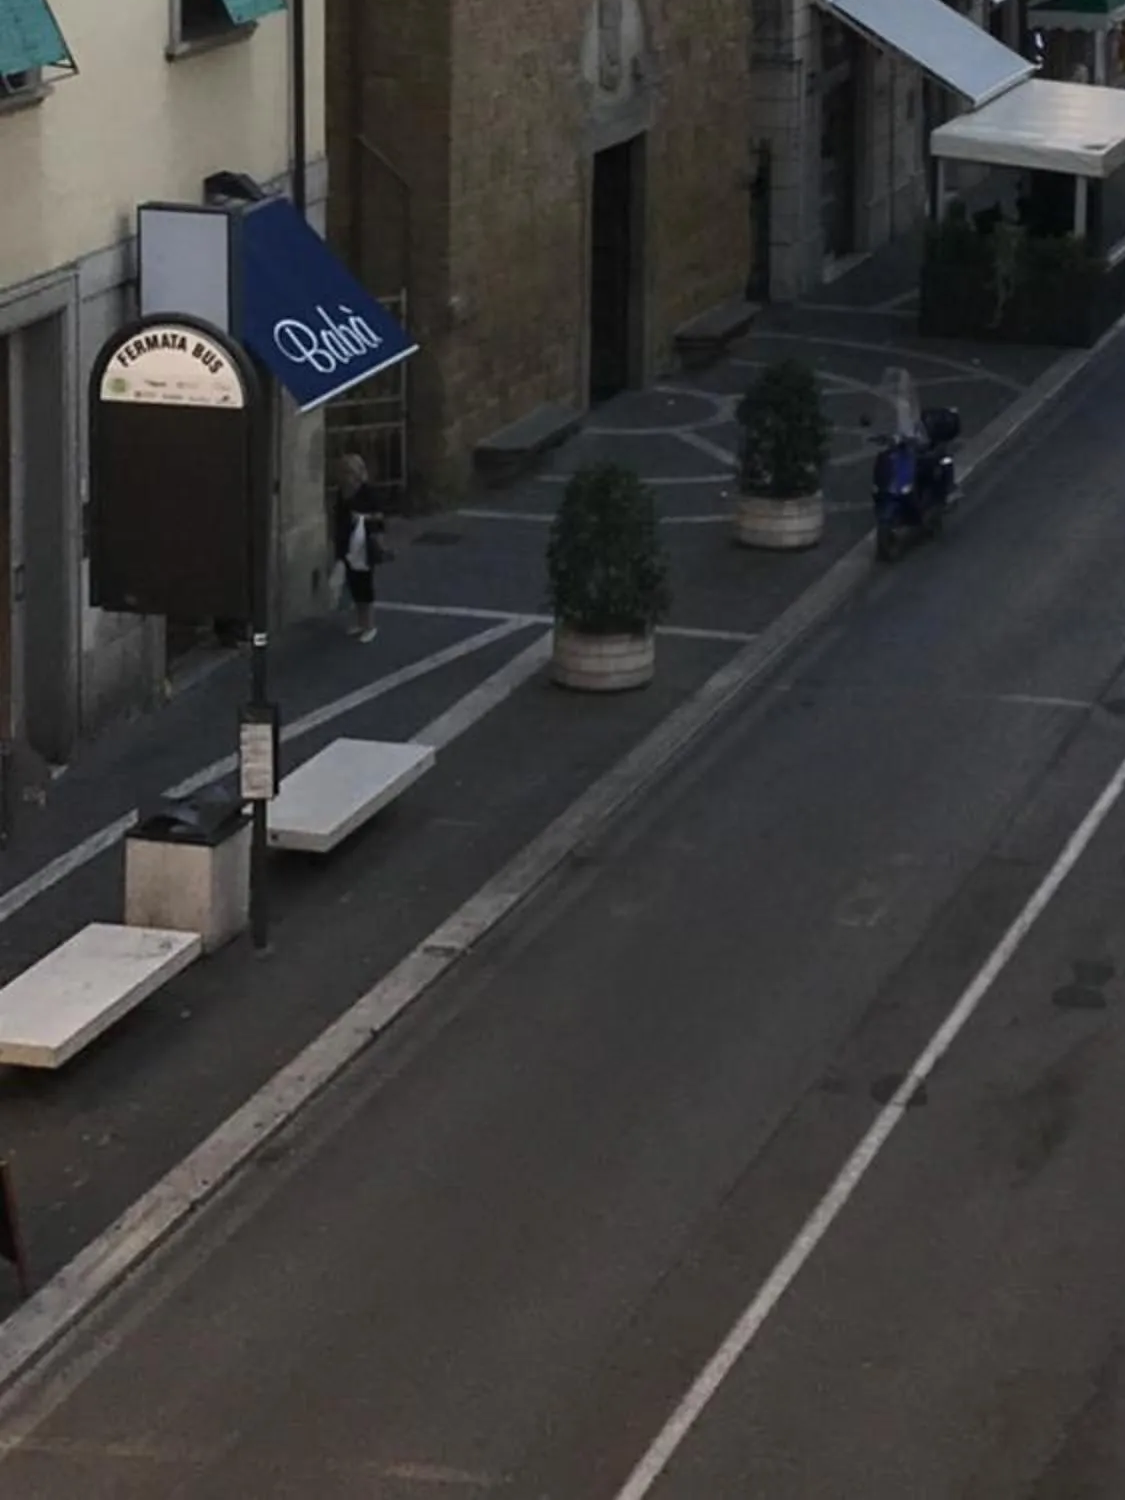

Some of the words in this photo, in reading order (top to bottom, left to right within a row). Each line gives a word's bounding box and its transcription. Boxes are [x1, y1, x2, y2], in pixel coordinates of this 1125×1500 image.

[117, 333, 187, 367] FERMATA
[191, 343, 224, 374] BUS
[273, 304, 383, 373] Babà
